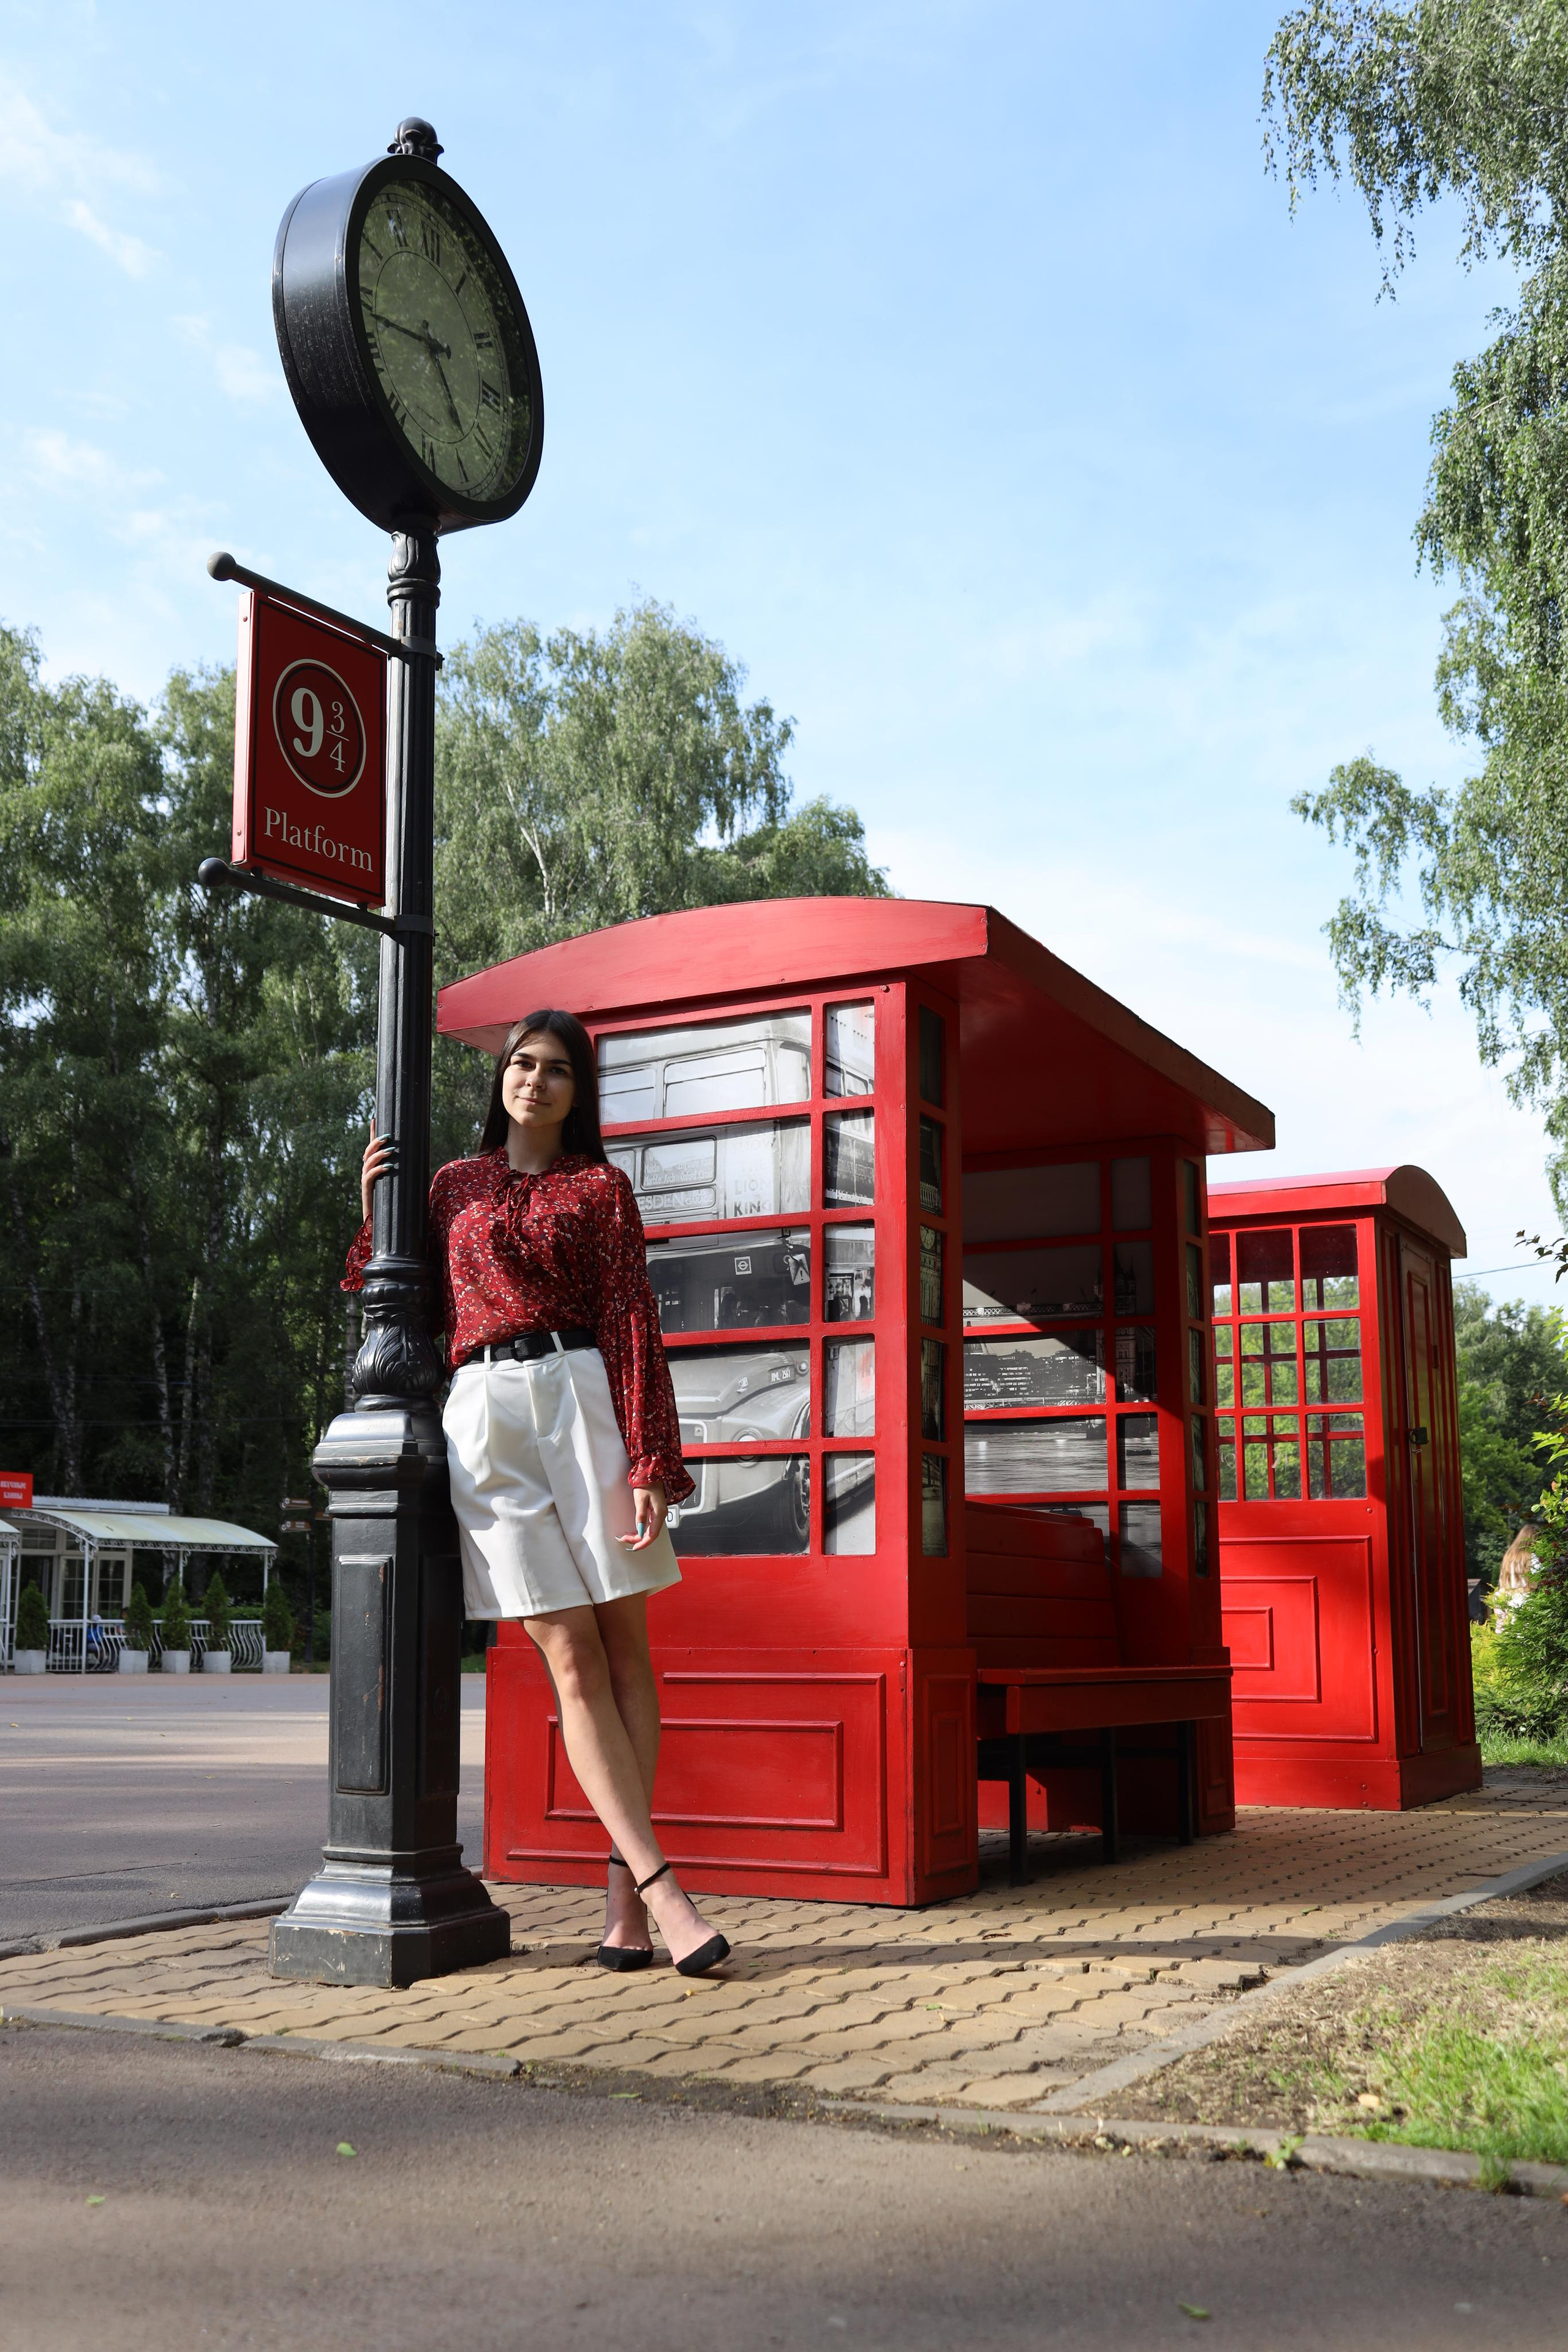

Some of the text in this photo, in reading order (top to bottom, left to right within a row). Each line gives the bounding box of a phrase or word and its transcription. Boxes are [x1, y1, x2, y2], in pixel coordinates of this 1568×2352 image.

[420, 219, 440, 268] XII
[473, 331, 493, 350] II
[481, 378, 500, 416] III
[264, 805, 374, 873] Platform
[734, 1178, 771, 1195] LION
[638, 1191, 684, 1211] ESDEN
[734, 1200, 772, 1217] KING
